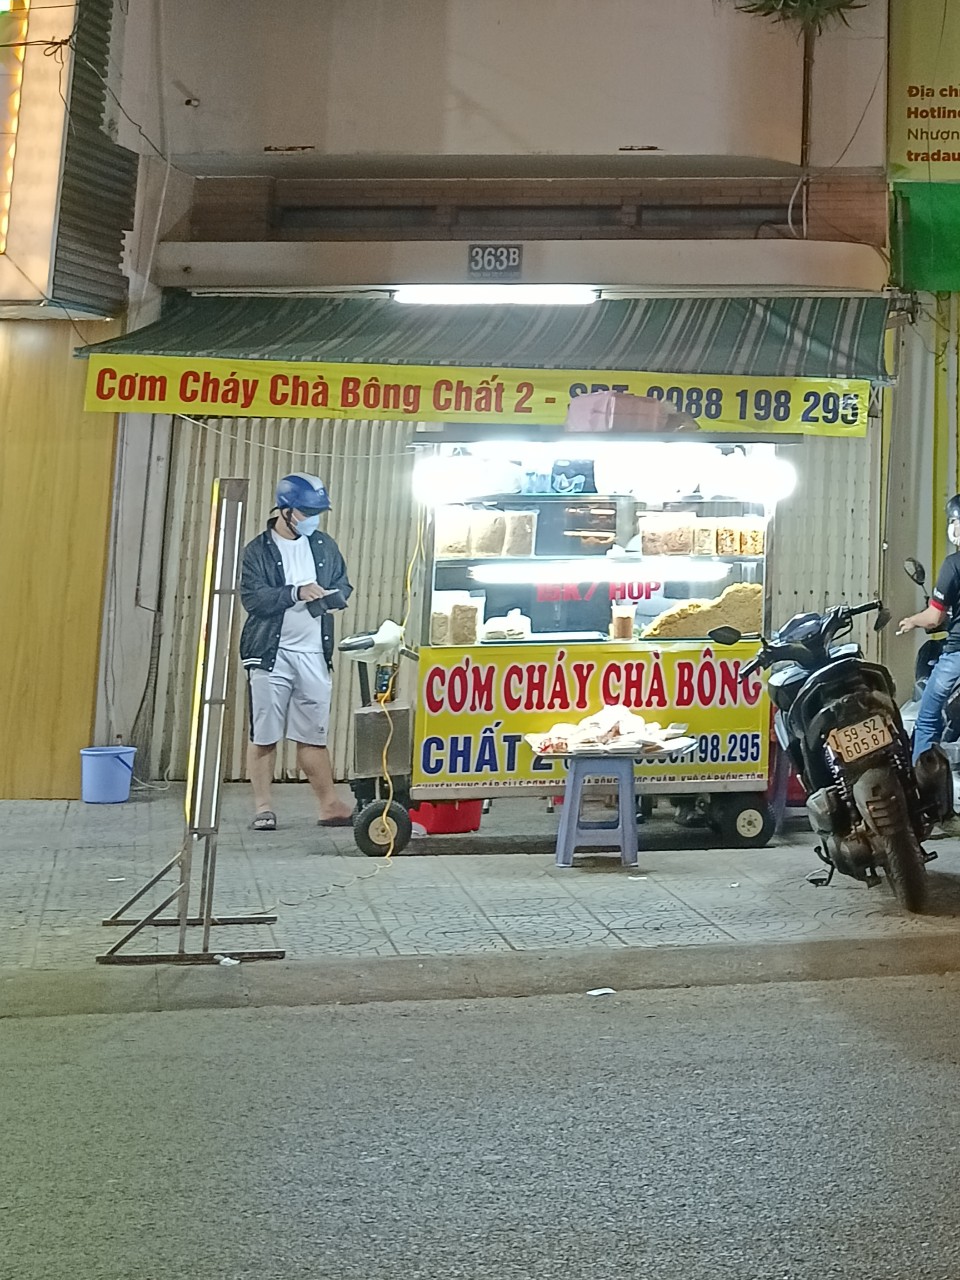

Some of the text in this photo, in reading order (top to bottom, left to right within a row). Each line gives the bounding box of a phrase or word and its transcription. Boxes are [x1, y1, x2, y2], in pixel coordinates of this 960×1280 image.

[907, 85, 935, 101] Địa
[471, 247, 519, 271] 363B
[96, 367, 168, 401] Cơm
[178, 370, 259, 409] Cháy
[269, 374, 329, 407] Chà
[340, 376, 421, 414] Bông
[432, 375, 505, 412] Chất
[514, 382, 534, 413] 2
[735, 389, 791, 422] 198
[801, 391, 858, 425] 295
[426, 647, 762, 713] CƠM CHÁY CHÀ BÔNG
[422, 721, 522, 774] CHẤT
[845, 729, 886, 758] 605.87
